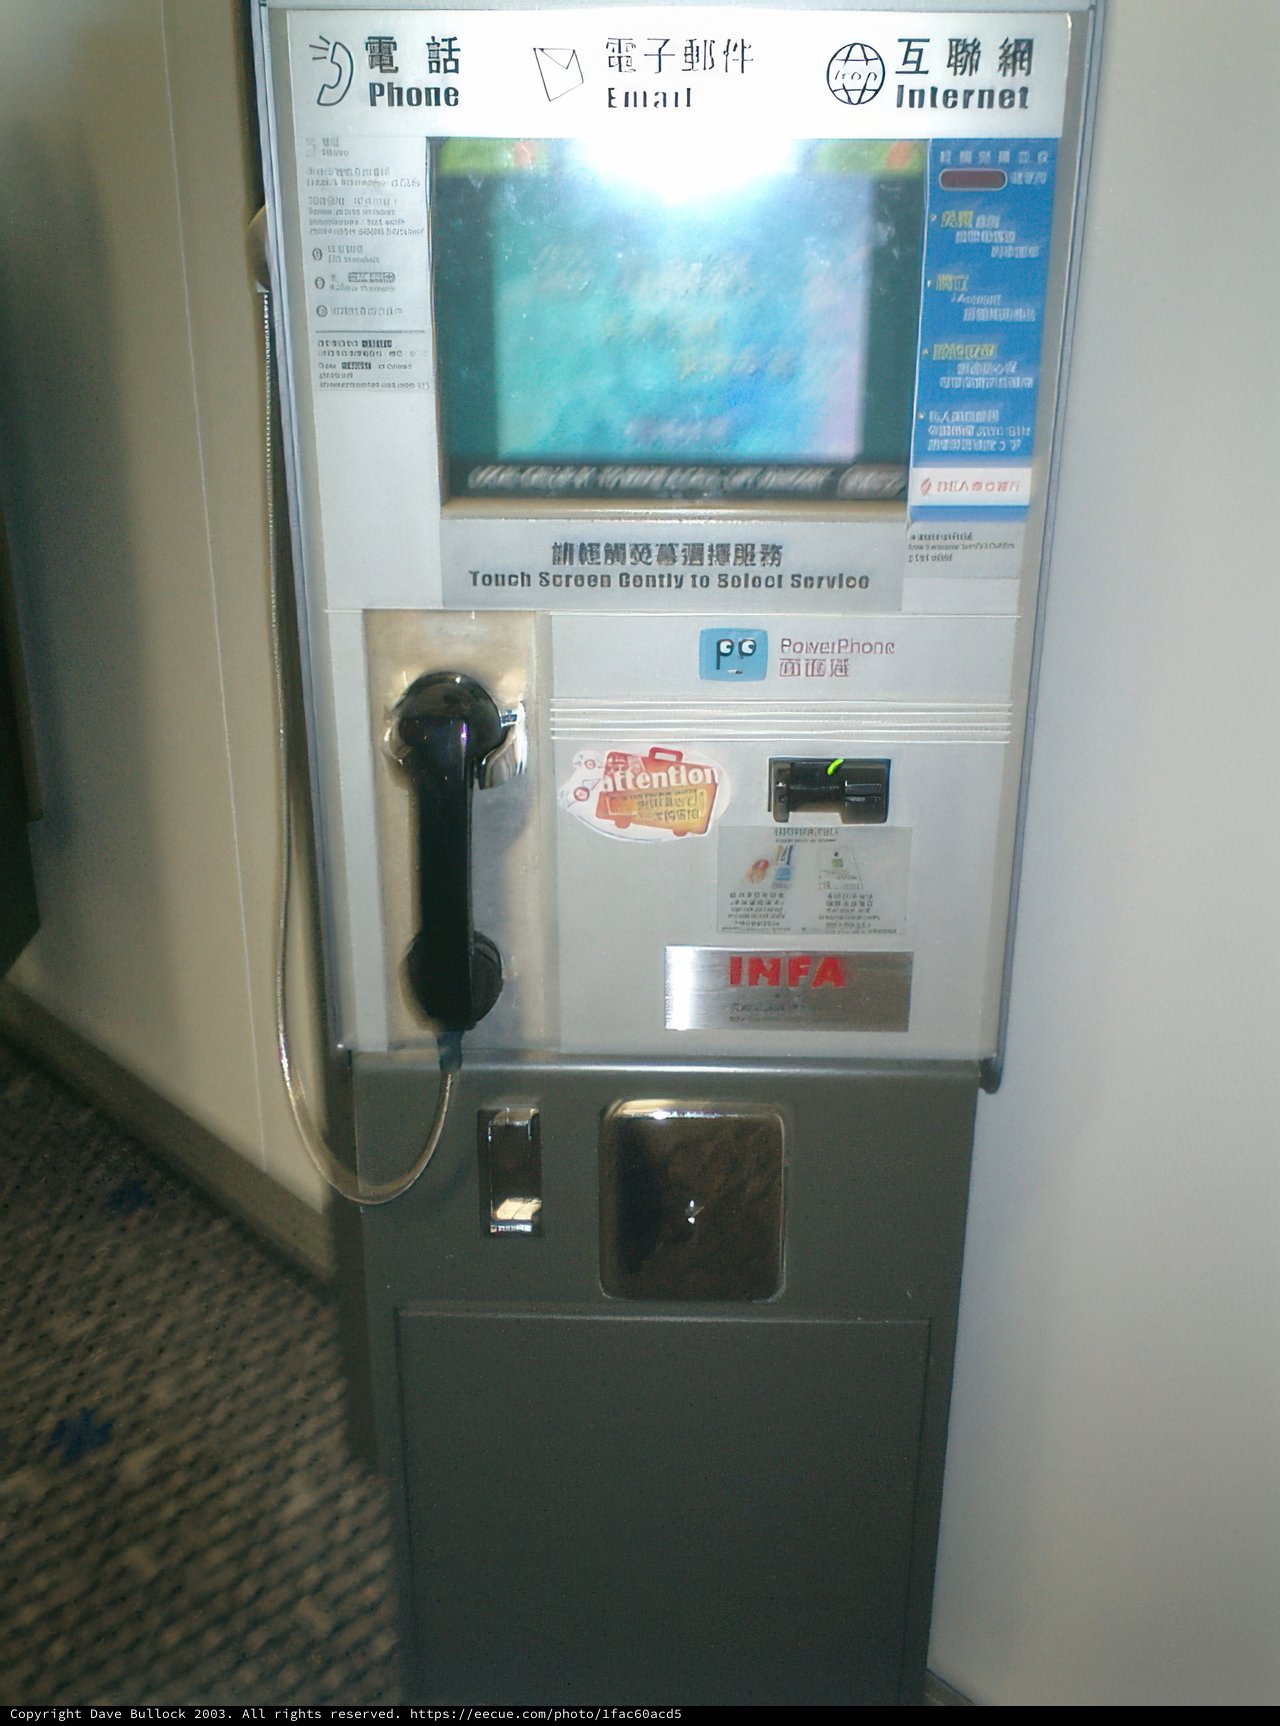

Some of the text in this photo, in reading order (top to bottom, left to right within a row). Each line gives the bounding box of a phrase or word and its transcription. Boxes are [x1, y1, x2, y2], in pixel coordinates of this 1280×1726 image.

[364, 35, 461, 74] 電話
[605, 38, 754, 74] 電子郵件
[895, 37, 1034, 78] 互聯網
[368, 81, 459, 107] Phone
[607, 87, 692, 109] Email
[896, 84, 1030, 109] Internet
[468, 570, 531, 588] Touch
[690, 574, 710, 588] to
[780, 637, 895, 655] PowerPhone
